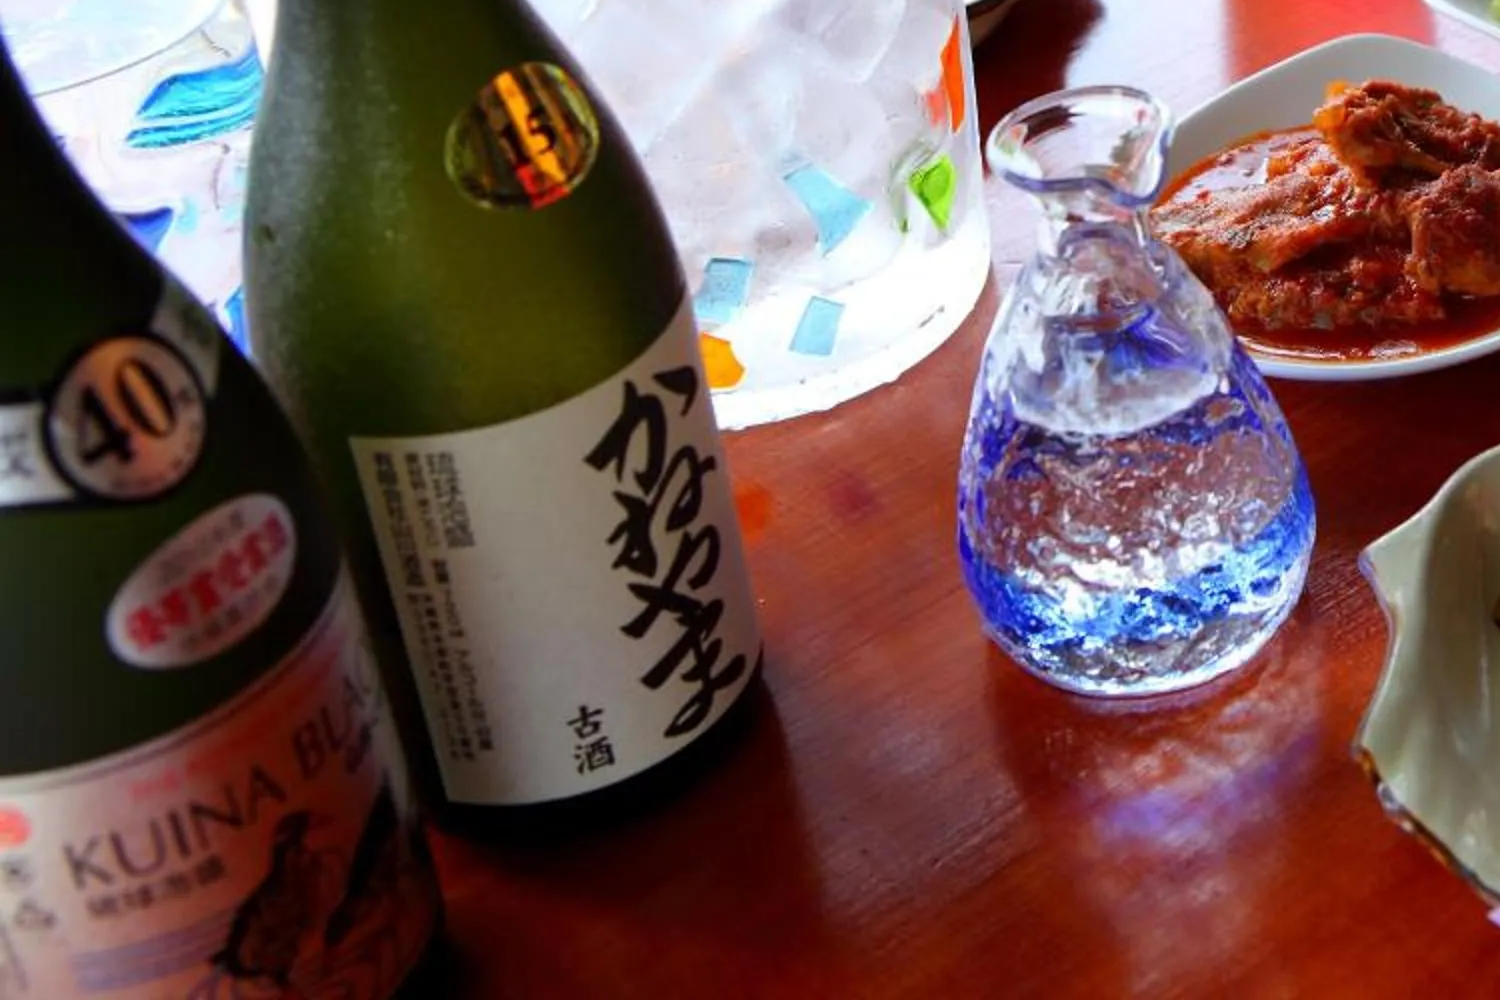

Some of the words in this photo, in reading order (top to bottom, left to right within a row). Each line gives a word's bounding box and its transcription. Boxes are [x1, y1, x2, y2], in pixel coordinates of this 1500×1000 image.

[78, 357, 176, 465] 40
[566, 705, 615, 775] 古酒
[62, 764, 288, 890] KUINA
